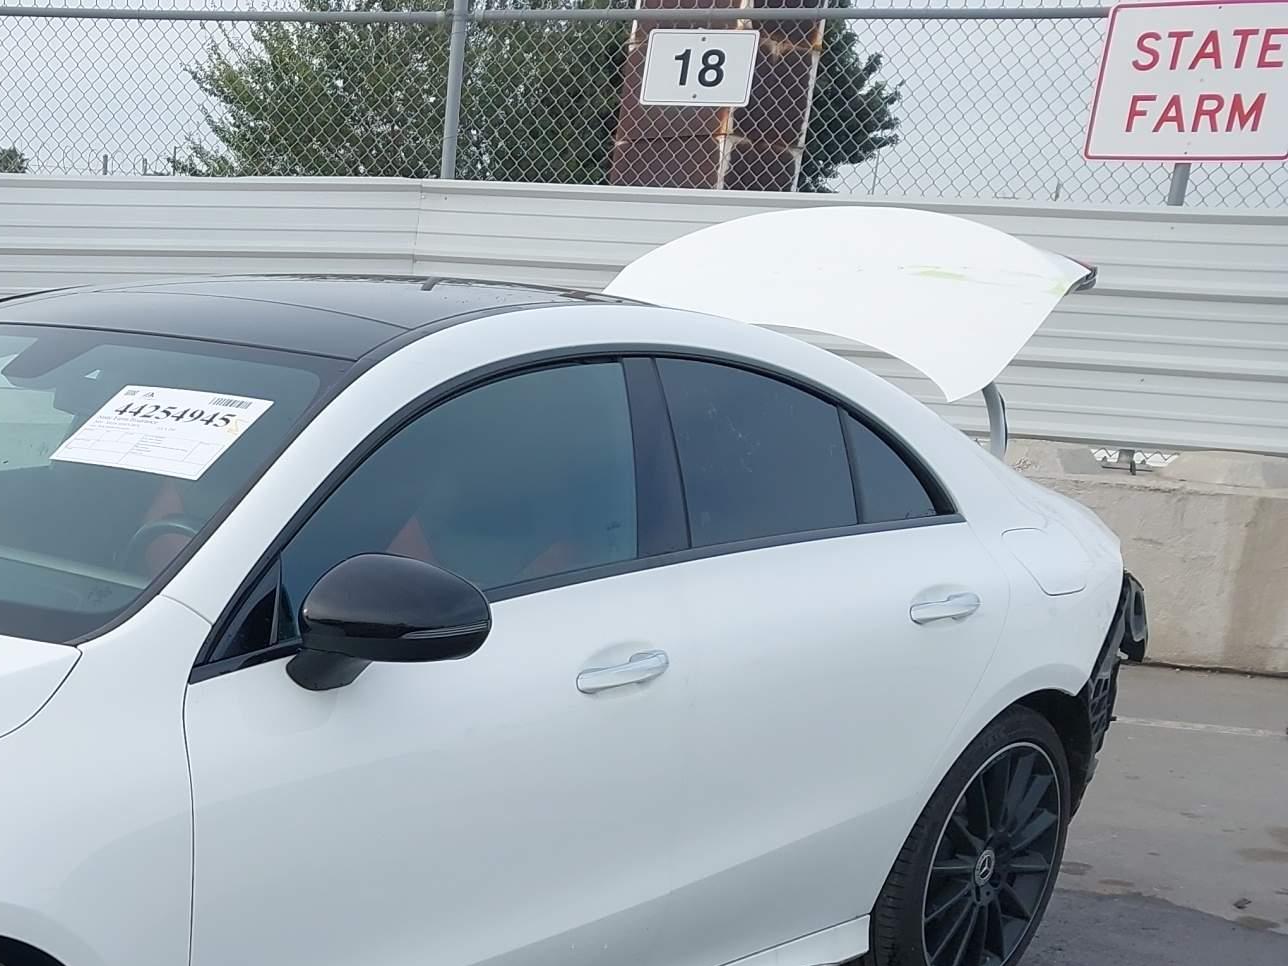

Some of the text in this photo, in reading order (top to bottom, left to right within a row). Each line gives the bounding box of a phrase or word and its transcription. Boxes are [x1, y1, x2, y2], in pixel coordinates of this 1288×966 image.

[674, 48, 726, 88] 18
[1131, 28, 1288, 71] STATE
[1125, 92, 1267, 132] FARM
[115, 402, 236, 429] 44254945
